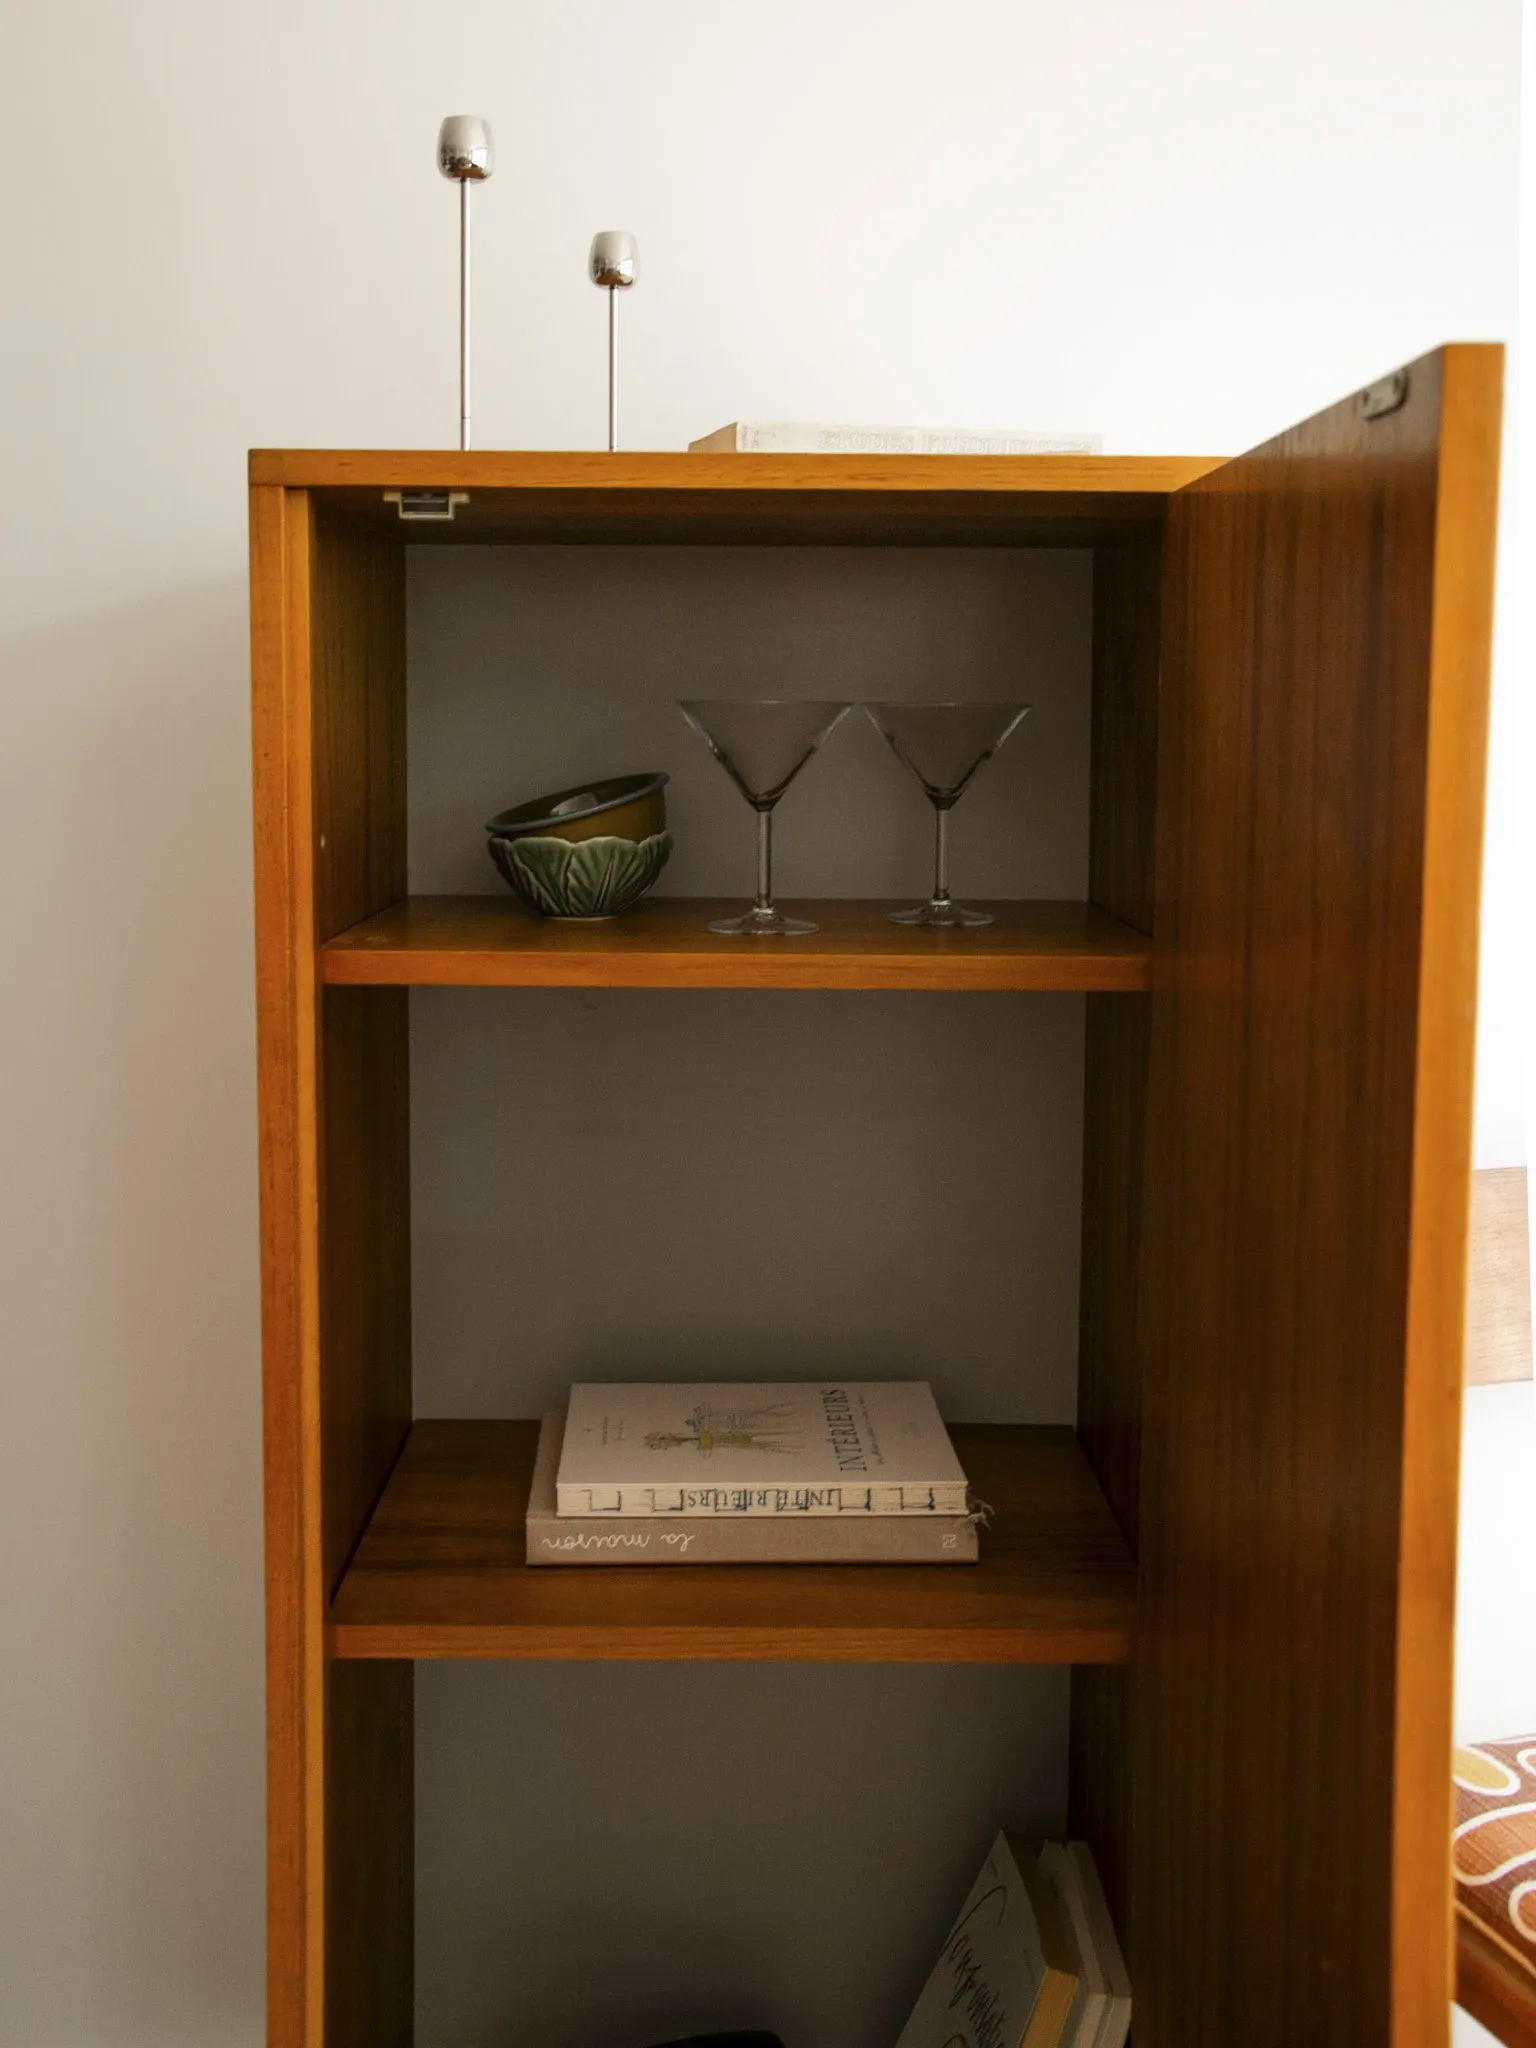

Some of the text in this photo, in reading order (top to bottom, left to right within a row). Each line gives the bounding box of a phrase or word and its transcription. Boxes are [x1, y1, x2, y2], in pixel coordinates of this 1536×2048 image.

[821, 1388, 868, 1473] INTÉRIEURS
[541, 1532, 696, 1552] la maison
